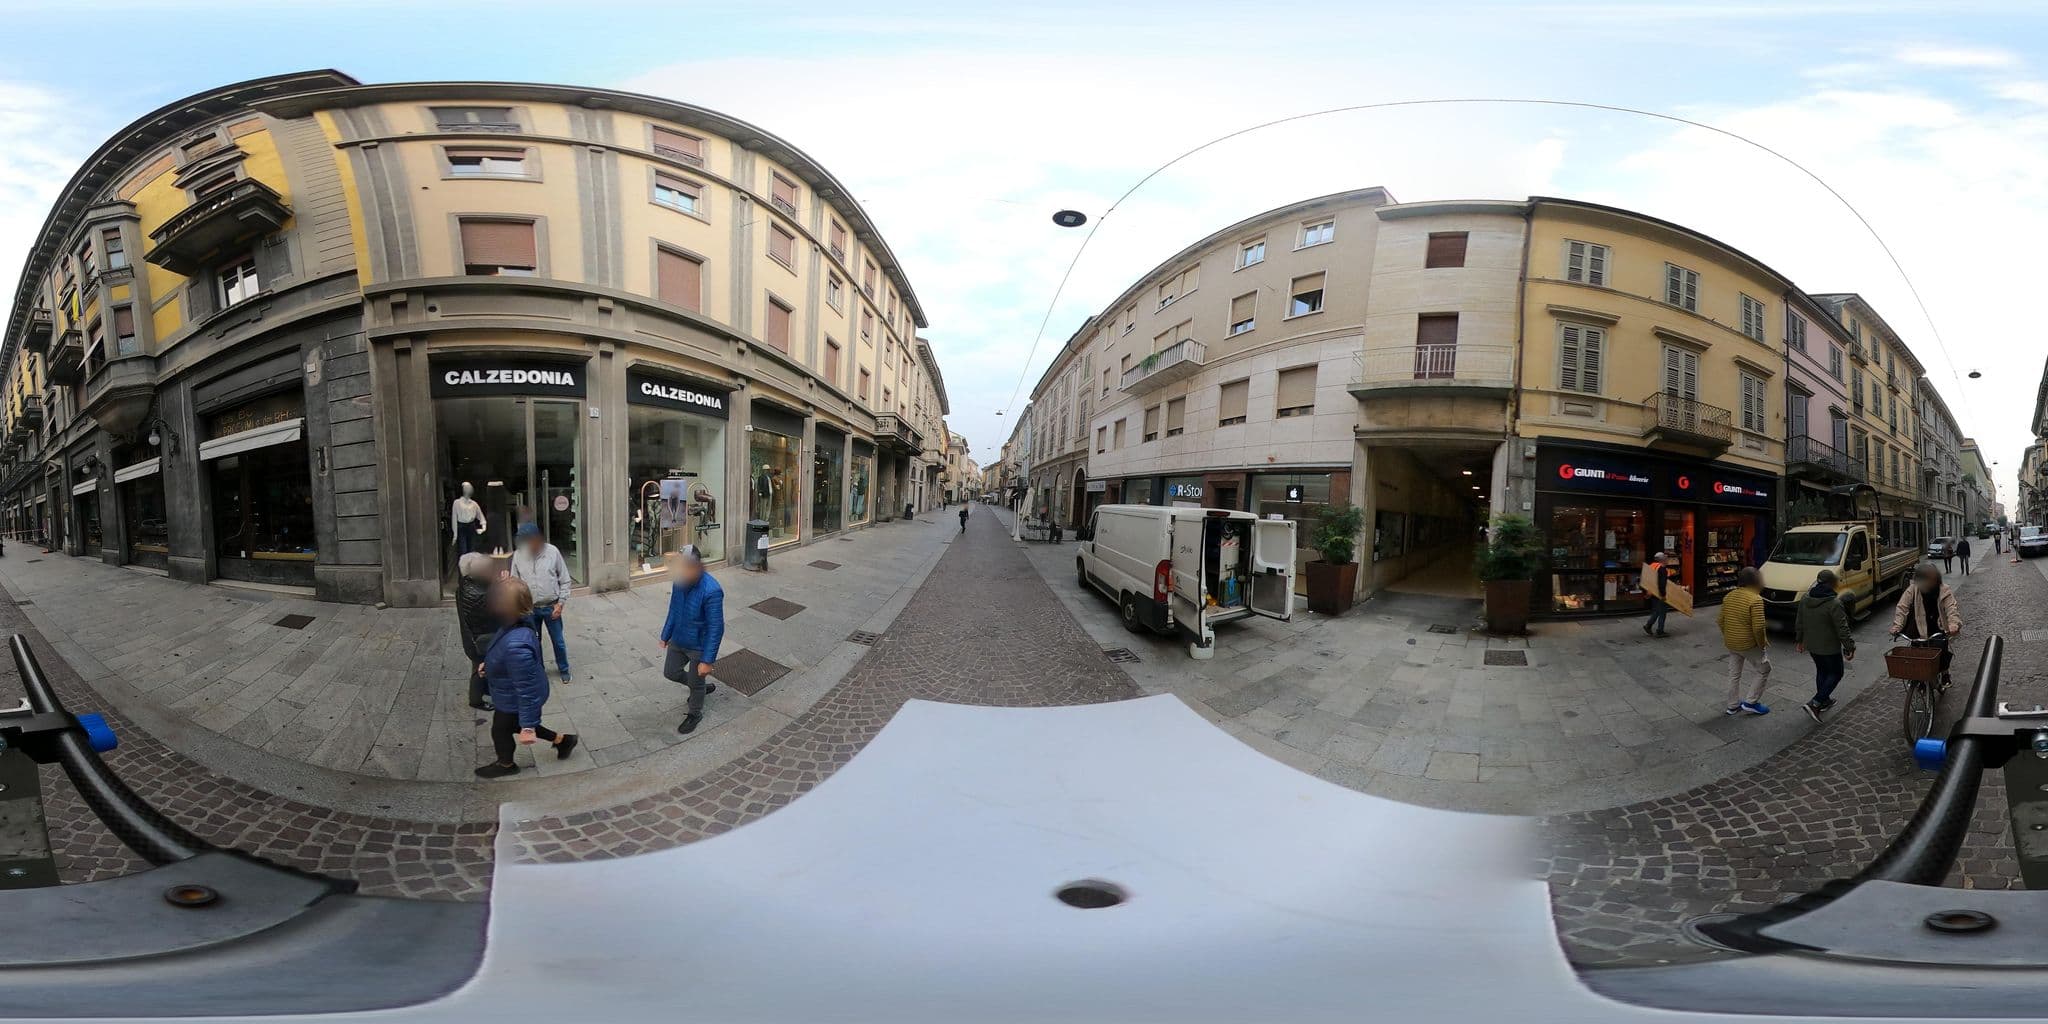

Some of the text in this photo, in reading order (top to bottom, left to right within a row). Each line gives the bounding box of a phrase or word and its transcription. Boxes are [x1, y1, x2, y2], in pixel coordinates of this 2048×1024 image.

[445, 370, 575, 386] CALZEDONIA
[641, 382, 722, 409] CALZEDONIA
[1574, 468, 1605, 479] GIUNTI
